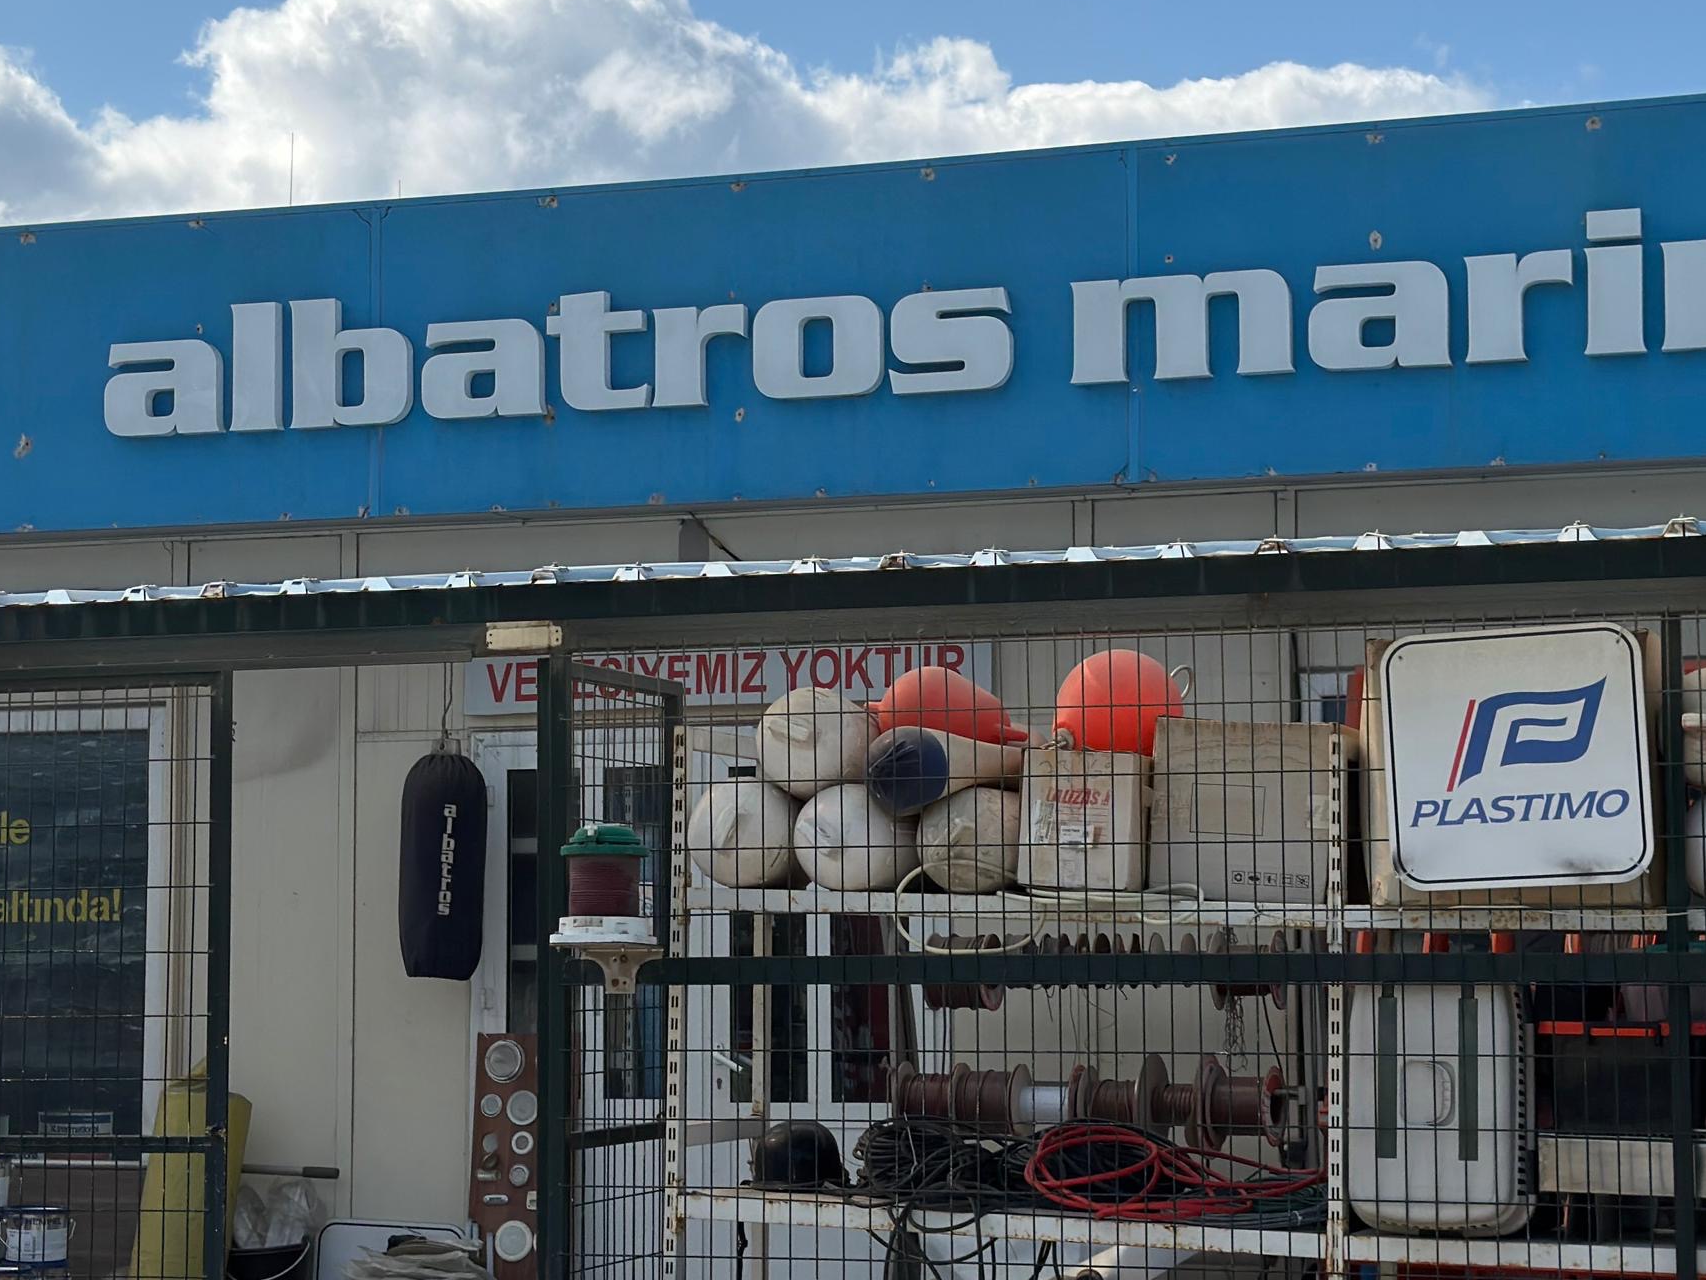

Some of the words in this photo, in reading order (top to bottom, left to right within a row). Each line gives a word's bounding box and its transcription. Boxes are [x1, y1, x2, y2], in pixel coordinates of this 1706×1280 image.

[104, 286, 1013, 438] albatros
[486, 652, 767, 703] VEESIYEMIZ
[779, 644, 965, 691] YOKTUR
[1409, 789, 1631, 828] PLASTIMO
[437, 804, 457, 916] albatros
